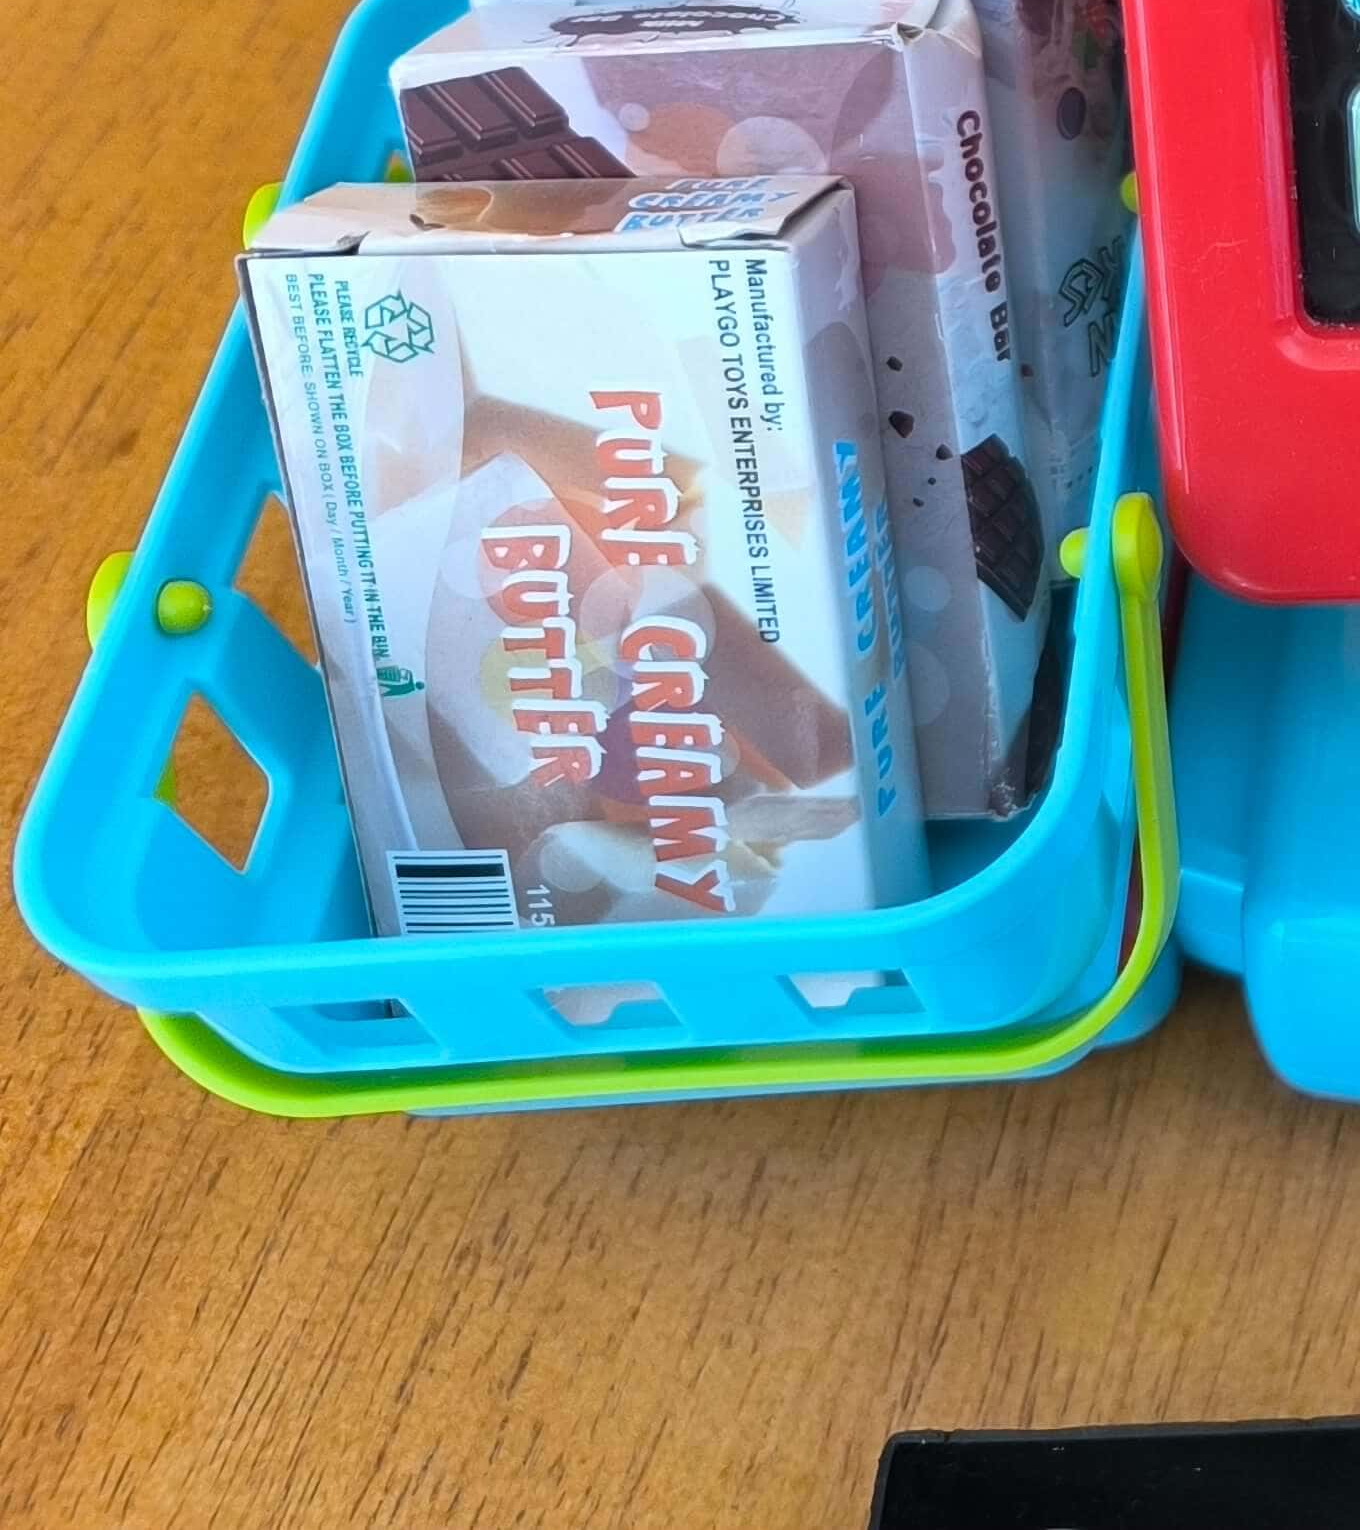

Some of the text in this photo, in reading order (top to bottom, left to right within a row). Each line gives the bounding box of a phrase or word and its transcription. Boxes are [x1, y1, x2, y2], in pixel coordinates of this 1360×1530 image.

[613, 204, 766, 233] BUTTER
[627, 190, 799, 210] CREAMY
[956, 109, 1012, 363] Chocolate Bar
[285, 273, 303, 312] BEST
[307, 272, 332, 327] PLEASE
[334, 279, 365, 378] PLEASE RECYCLE
[744, 259, 785, 432] Manufactured by:
[316, 329, 343, 390] FLATTEN
[303, 381, 325, 435] SHOWN
[327, 392, 349, 421] THE
[314, 438, 329, 459] ON
[333, 423, 355, 452] BOX
[708, 259, 781, 644] PLAYGO TOYS ENTERPRISES LIMITED
[318, 462, 334, 492] BOX
[339, 454, 364, 509] BEFORE
[325, 500, 338, 528] Day
[331, 536, 349, 578] Month
[349, 511, 375, 569] PUTTING
[361, 570, 377, 585] IT
[363, 587, 380, 602] IN
[341, 587, 355, 618] Year
[366, 604, 386, 633] THE
[831, 437, 898, 818] PURE CREAMY
[480, 524, 611, 787] BUTTER
[588, 390, 736, 913] PURE CREAMY
